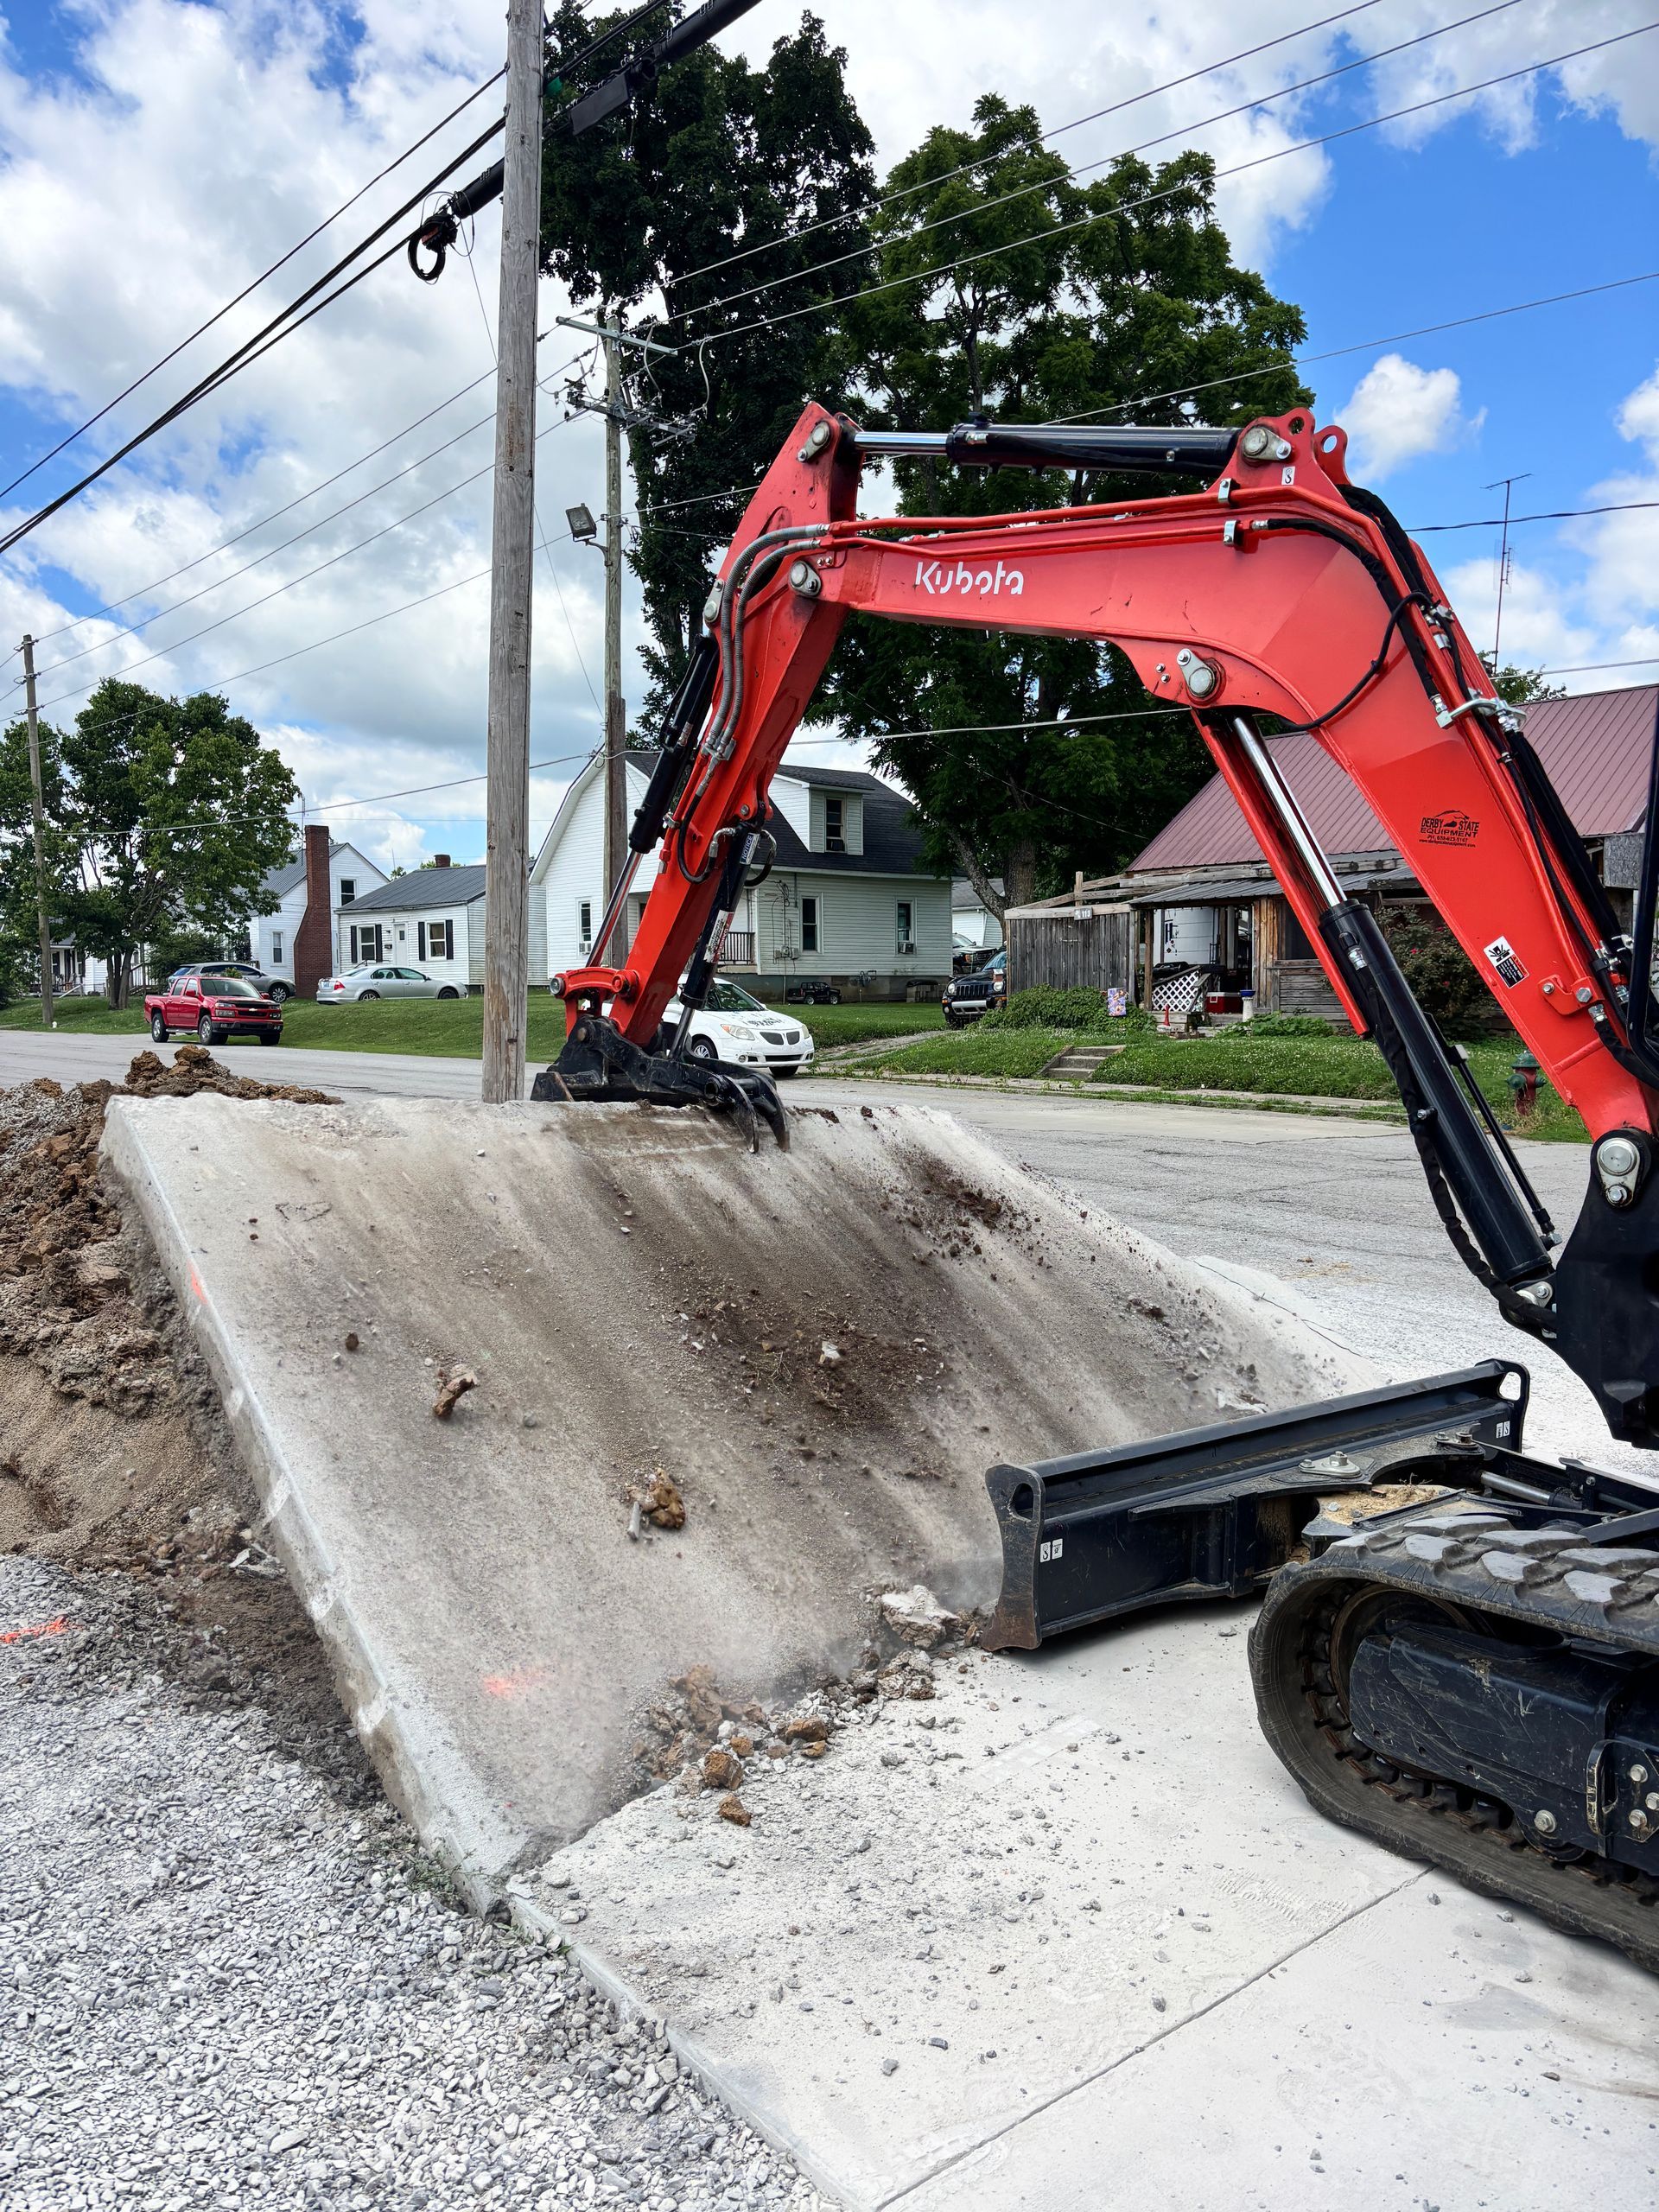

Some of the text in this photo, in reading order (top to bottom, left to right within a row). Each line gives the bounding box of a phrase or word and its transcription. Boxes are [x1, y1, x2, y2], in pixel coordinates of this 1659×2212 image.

[915, 561, 1024, 595] Kubota
[1420, 827, 1478, 837] EQUIPMENT
[1421, 817, 1480, 832] DERBY STATE
[741, 835, 753, 860] NOTICE
